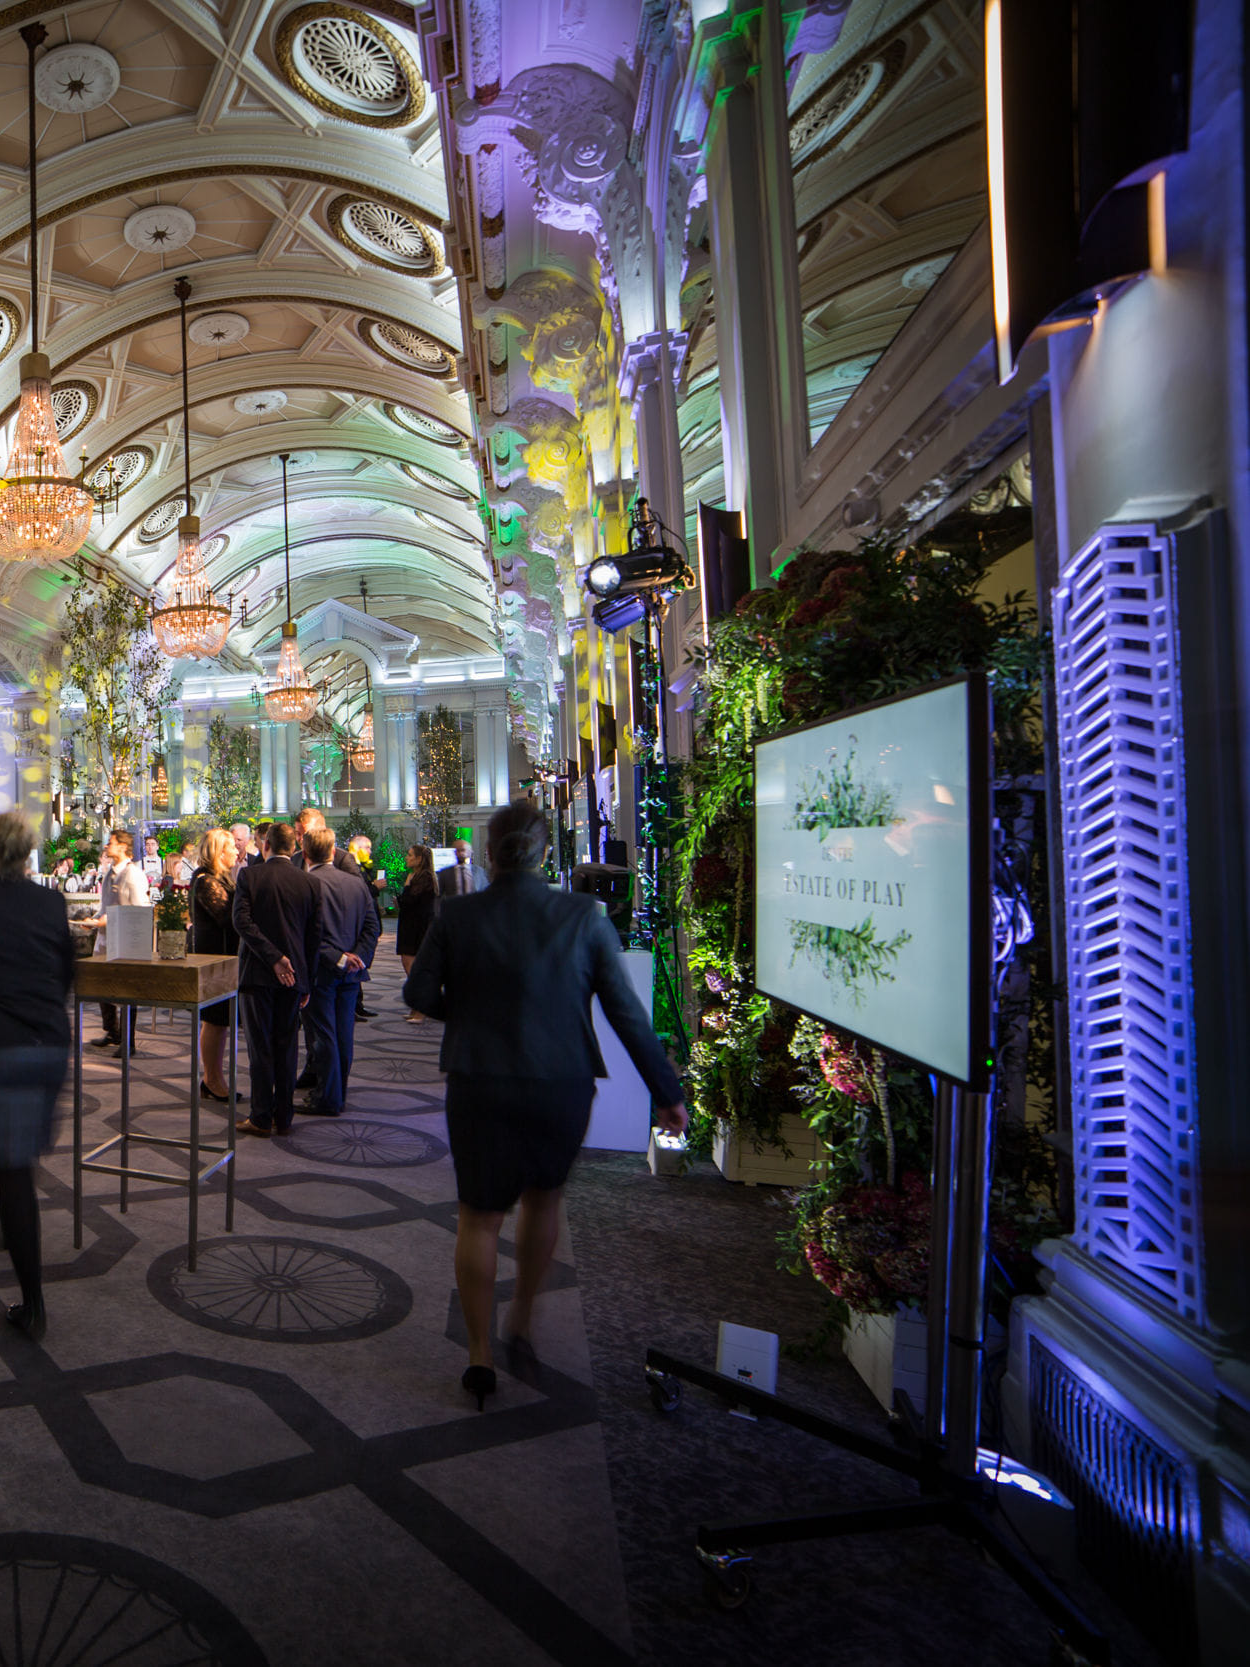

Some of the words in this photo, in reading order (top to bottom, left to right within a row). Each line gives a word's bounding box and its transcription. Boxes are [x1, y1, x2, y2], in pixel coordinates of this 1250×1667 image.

[784, 873, 833, 899] ESTATE
[837, 877, 857, 901] OF
[862, 879, 907, 907] PLAY
